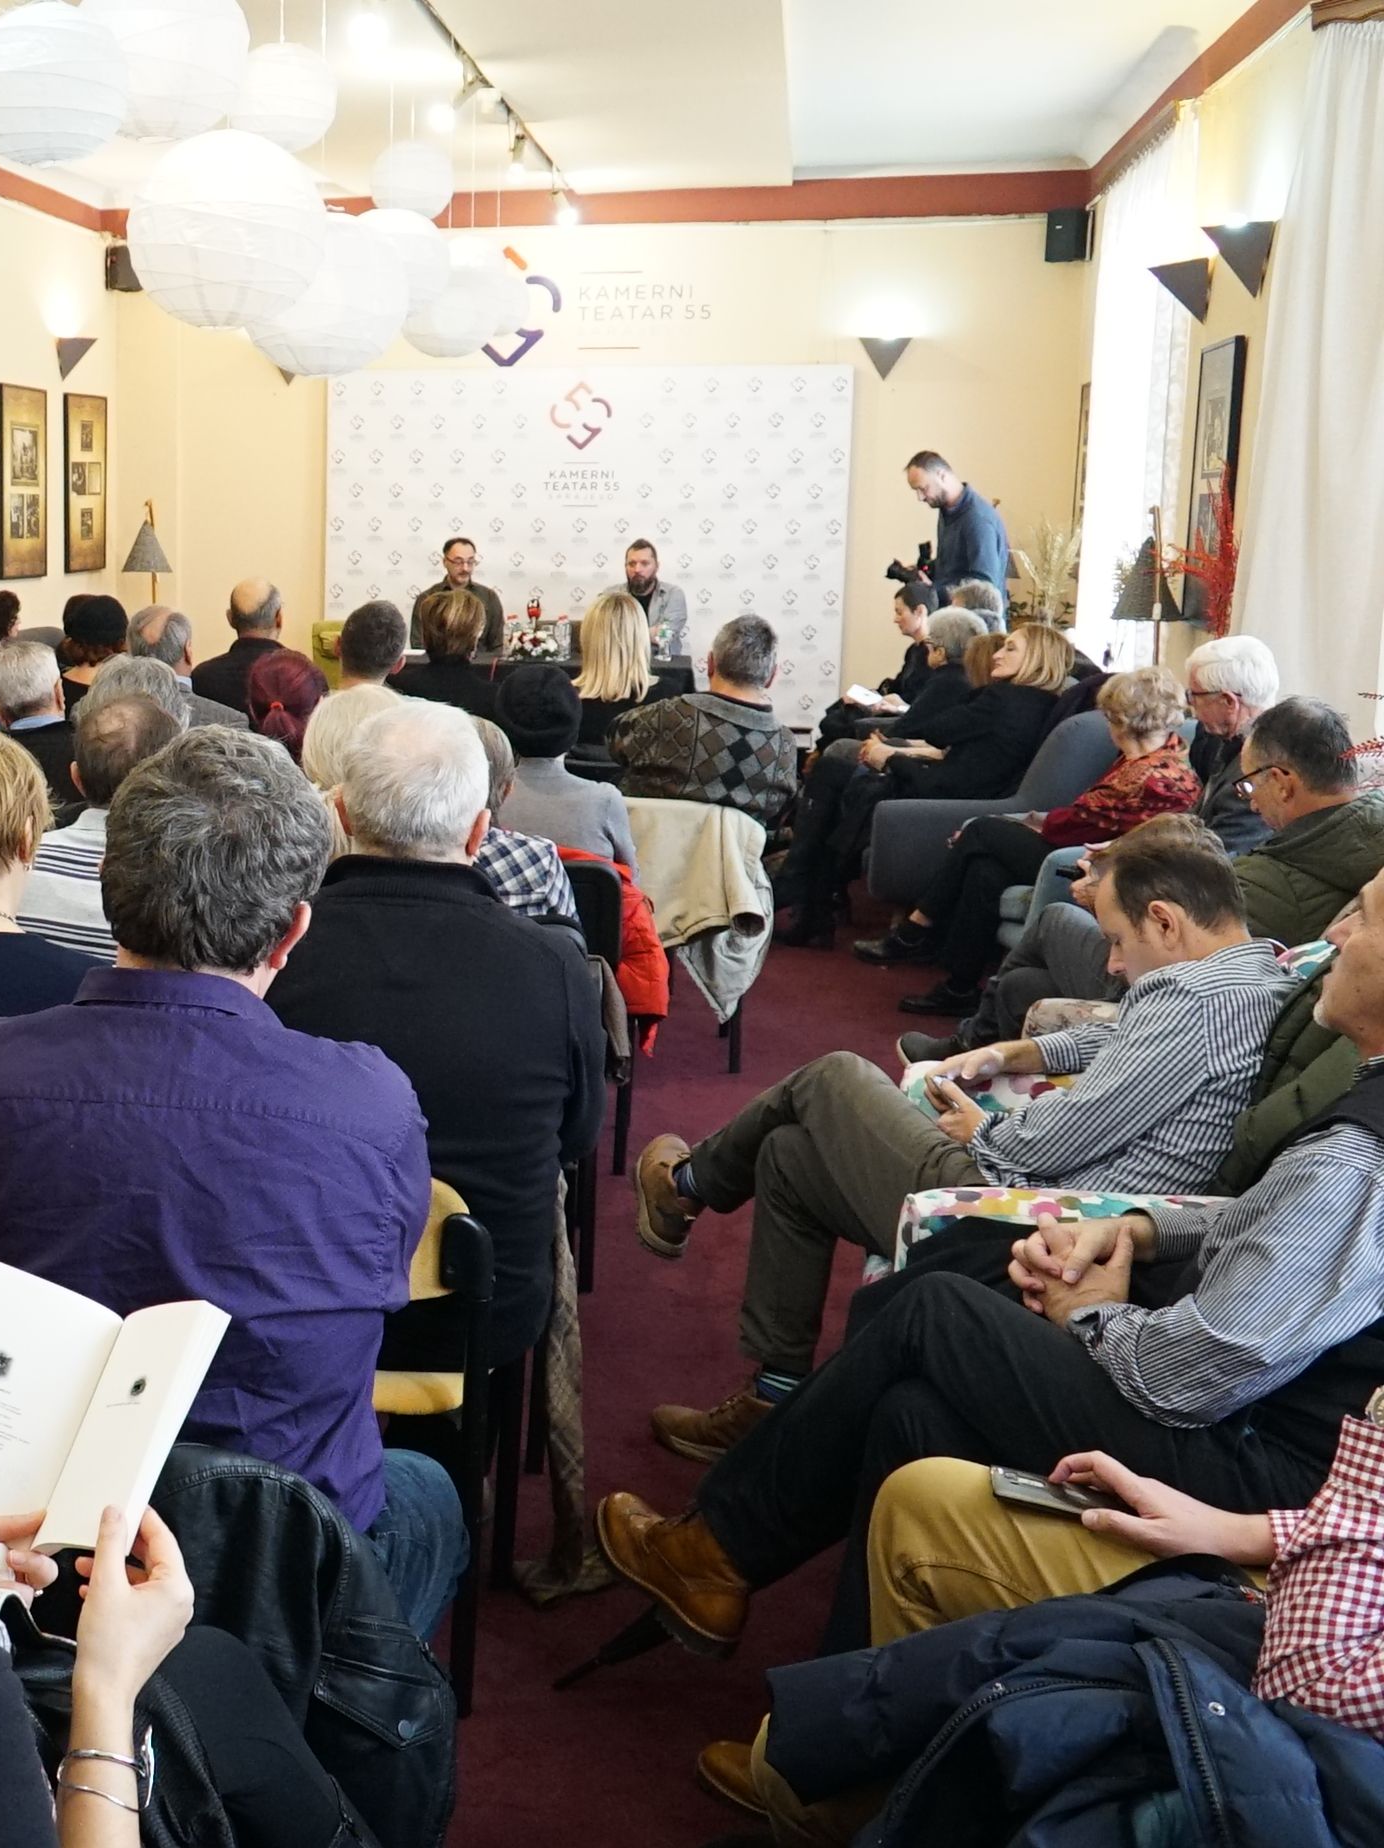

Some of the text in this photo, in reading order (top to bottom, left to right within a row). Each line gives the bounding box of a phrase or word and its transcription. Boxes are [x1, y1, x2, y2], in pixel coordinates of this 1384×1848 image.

[579, 284, 694, 301] KAMERNI
[578, 304, 712, 321] TEATAR 55
[548, 469, 616, 480] KAMERNI
[543, 481, 621, 491] TEATAR 55
